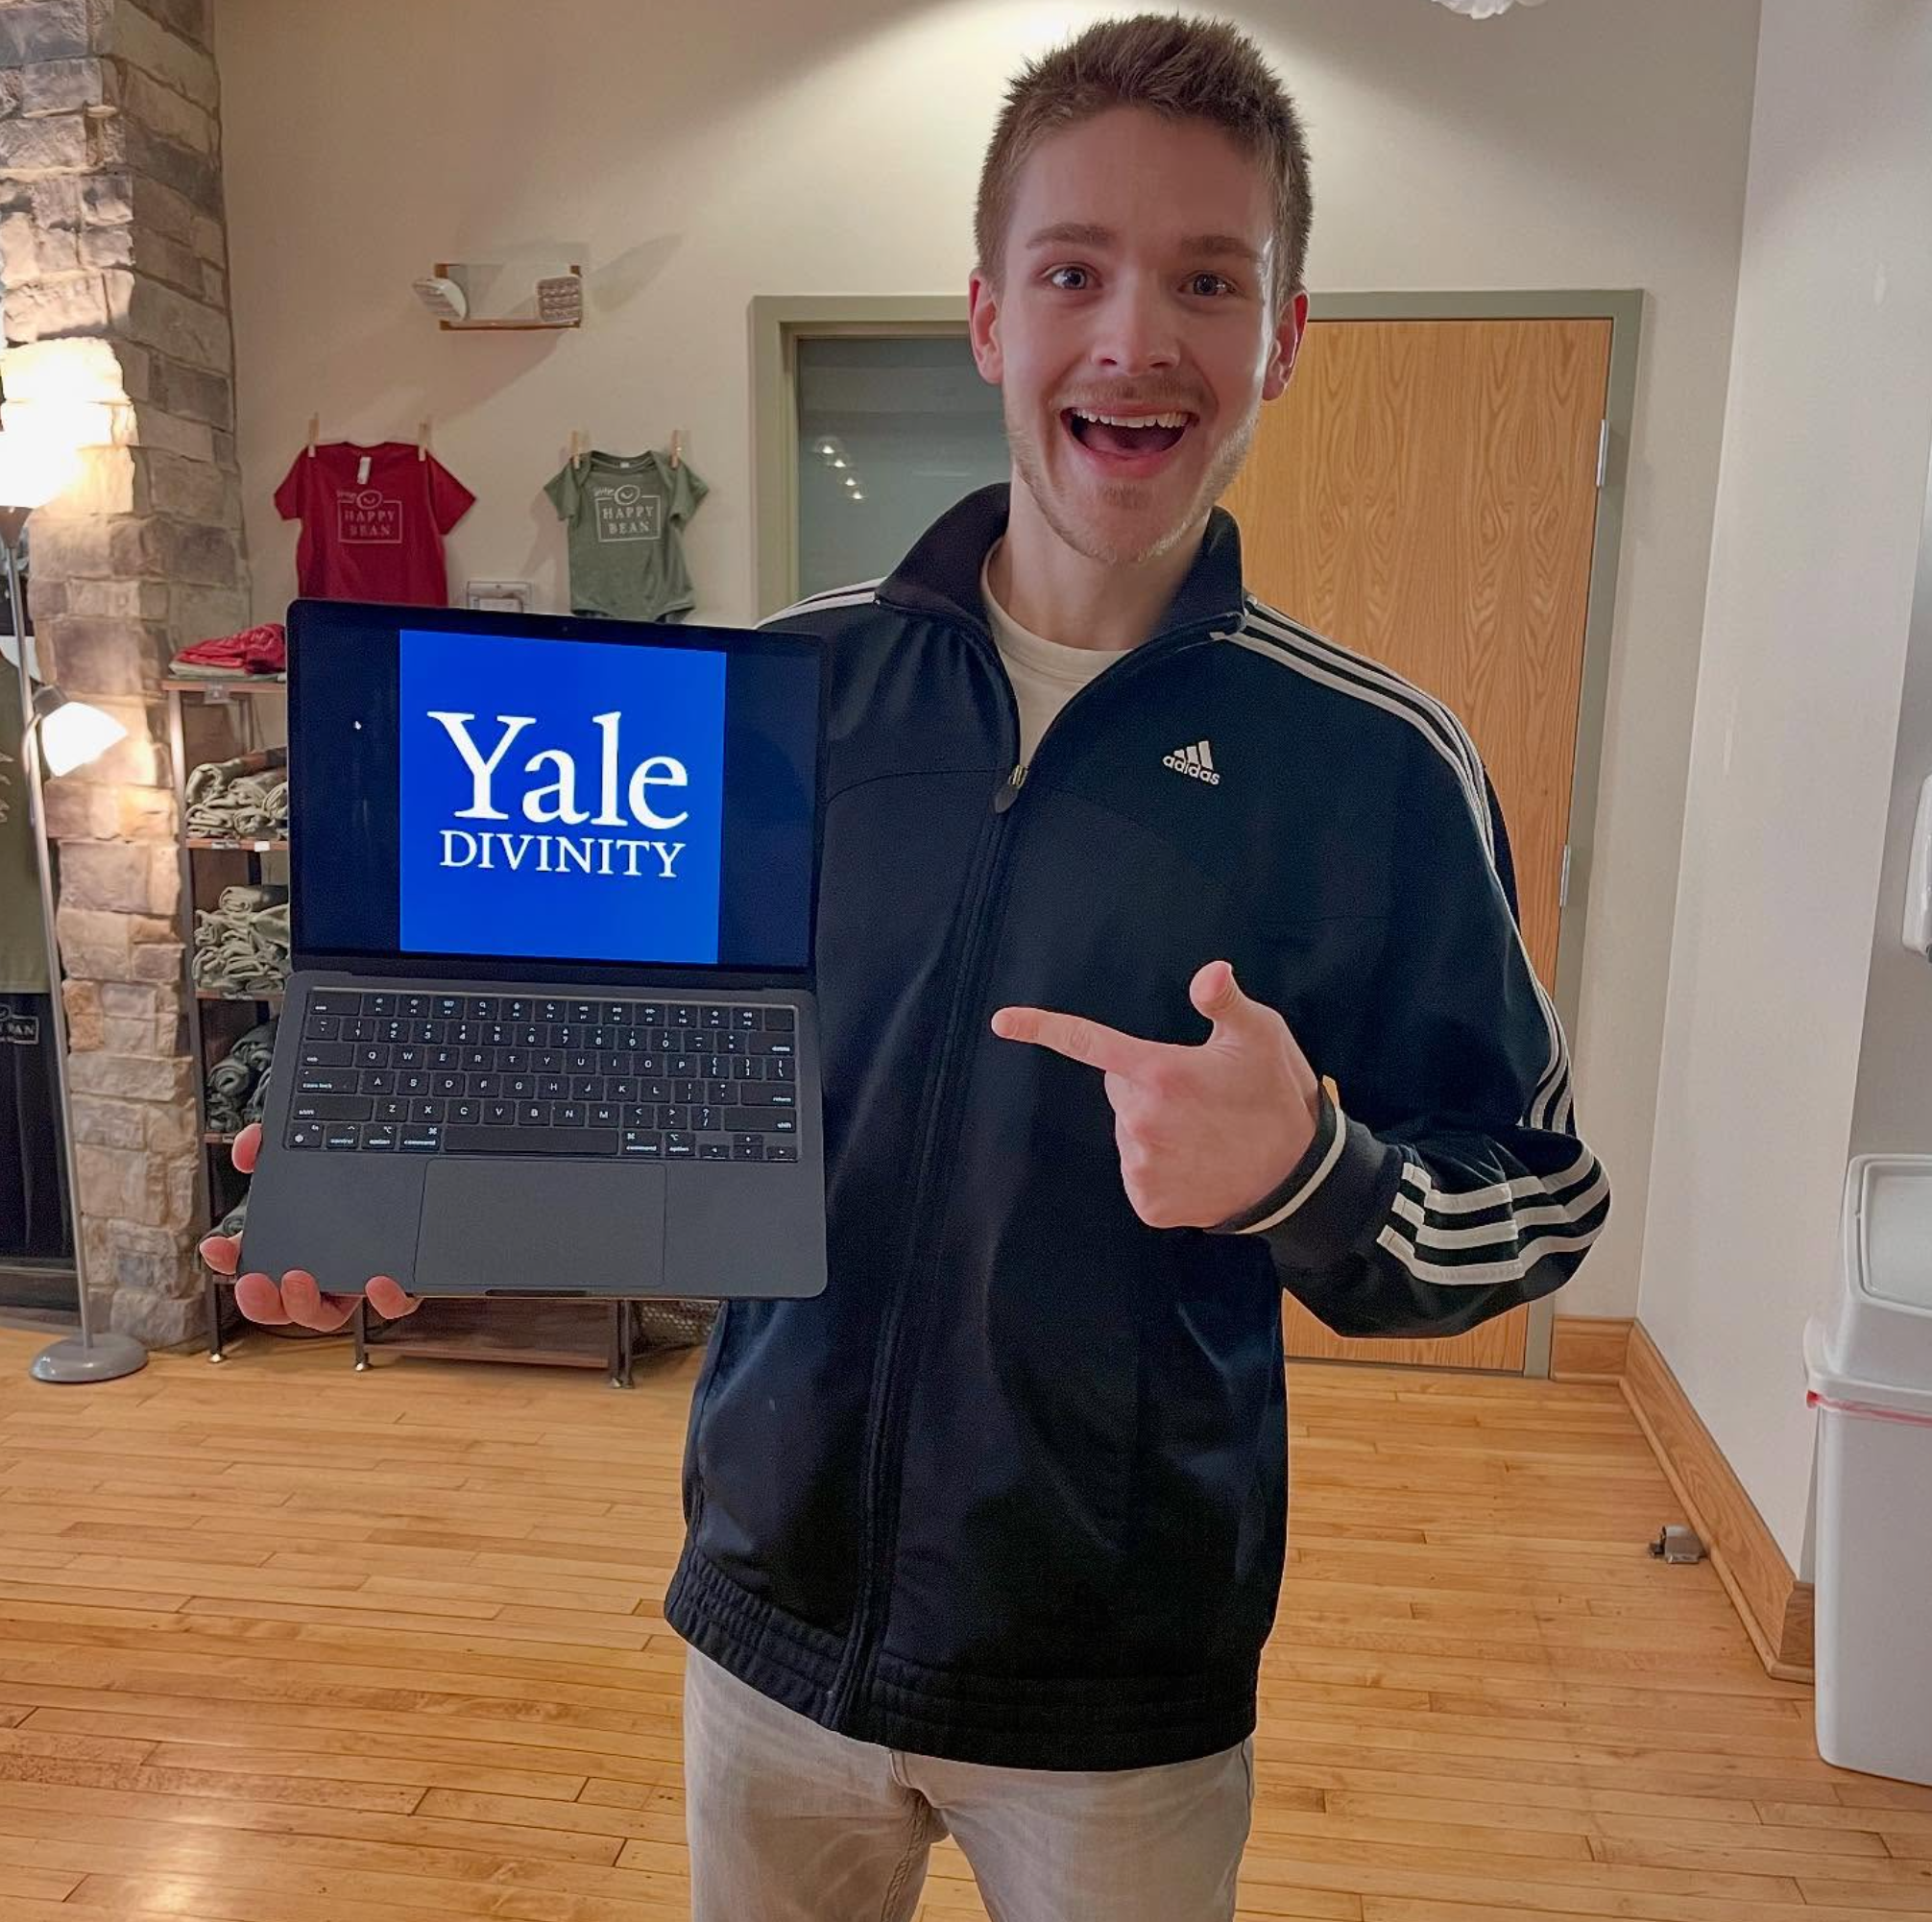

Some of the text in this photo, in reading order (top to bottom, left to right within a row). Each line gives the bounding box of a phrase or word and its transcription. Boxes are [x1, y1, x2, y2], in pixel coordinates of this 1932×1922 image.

[344, 510, 396, 521] HAPPY
[602, 506, 655, 519] HAPPY
[350, 525, 392, 537] BEAN
[608, 521, 650, 535] BEAN
[426, 710, 688, 829] Yale
[1162, 756, 1220, 785] adidas
[439, 829, 686, 877] DIVINITY
[595, 1037, 602, 1045] 8
[439, 1053, 447, 1062] E
[474, 1054, 482, 1063] R
[374, 1077, 382, 1086] A
[410, 1078, 418, 1087] S
[480, 1080, 488, 1089] F
[585, 1084, 592, 1093] J
[389, 1104, 397, 1113] Z
[424, 1105, 432, 1114] X
[565, 1109, 574, 1118] N
[599, 1111, 609, 1119] M
